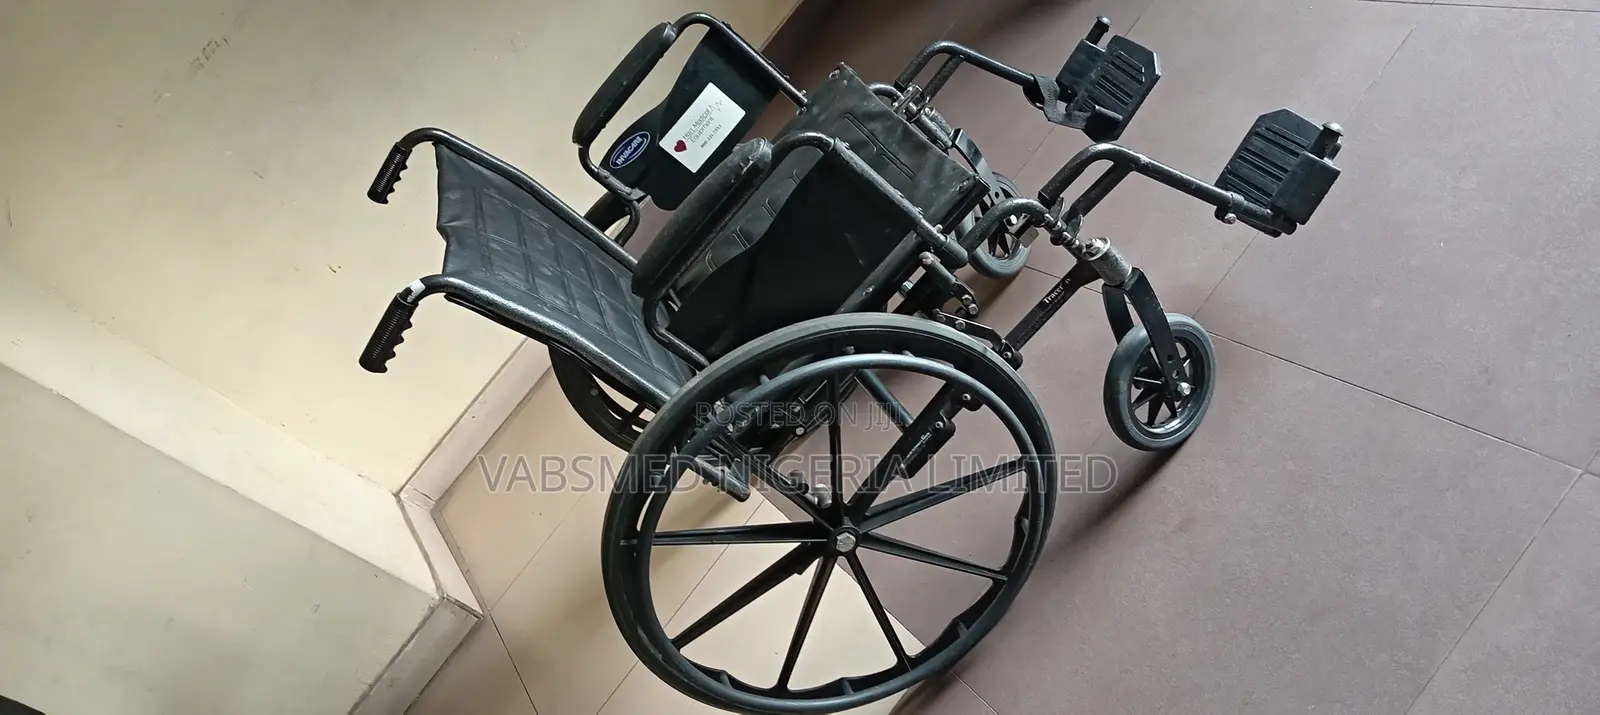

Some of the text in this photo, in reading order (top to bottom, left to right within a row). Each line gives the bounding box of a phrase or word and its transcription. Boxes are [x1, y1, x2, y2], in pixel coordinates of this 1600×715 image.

[691, 117, 715, 143] Equipment
[692, 108, 711, 128] Medical
[616, 135, 643, 166] INVACARE
